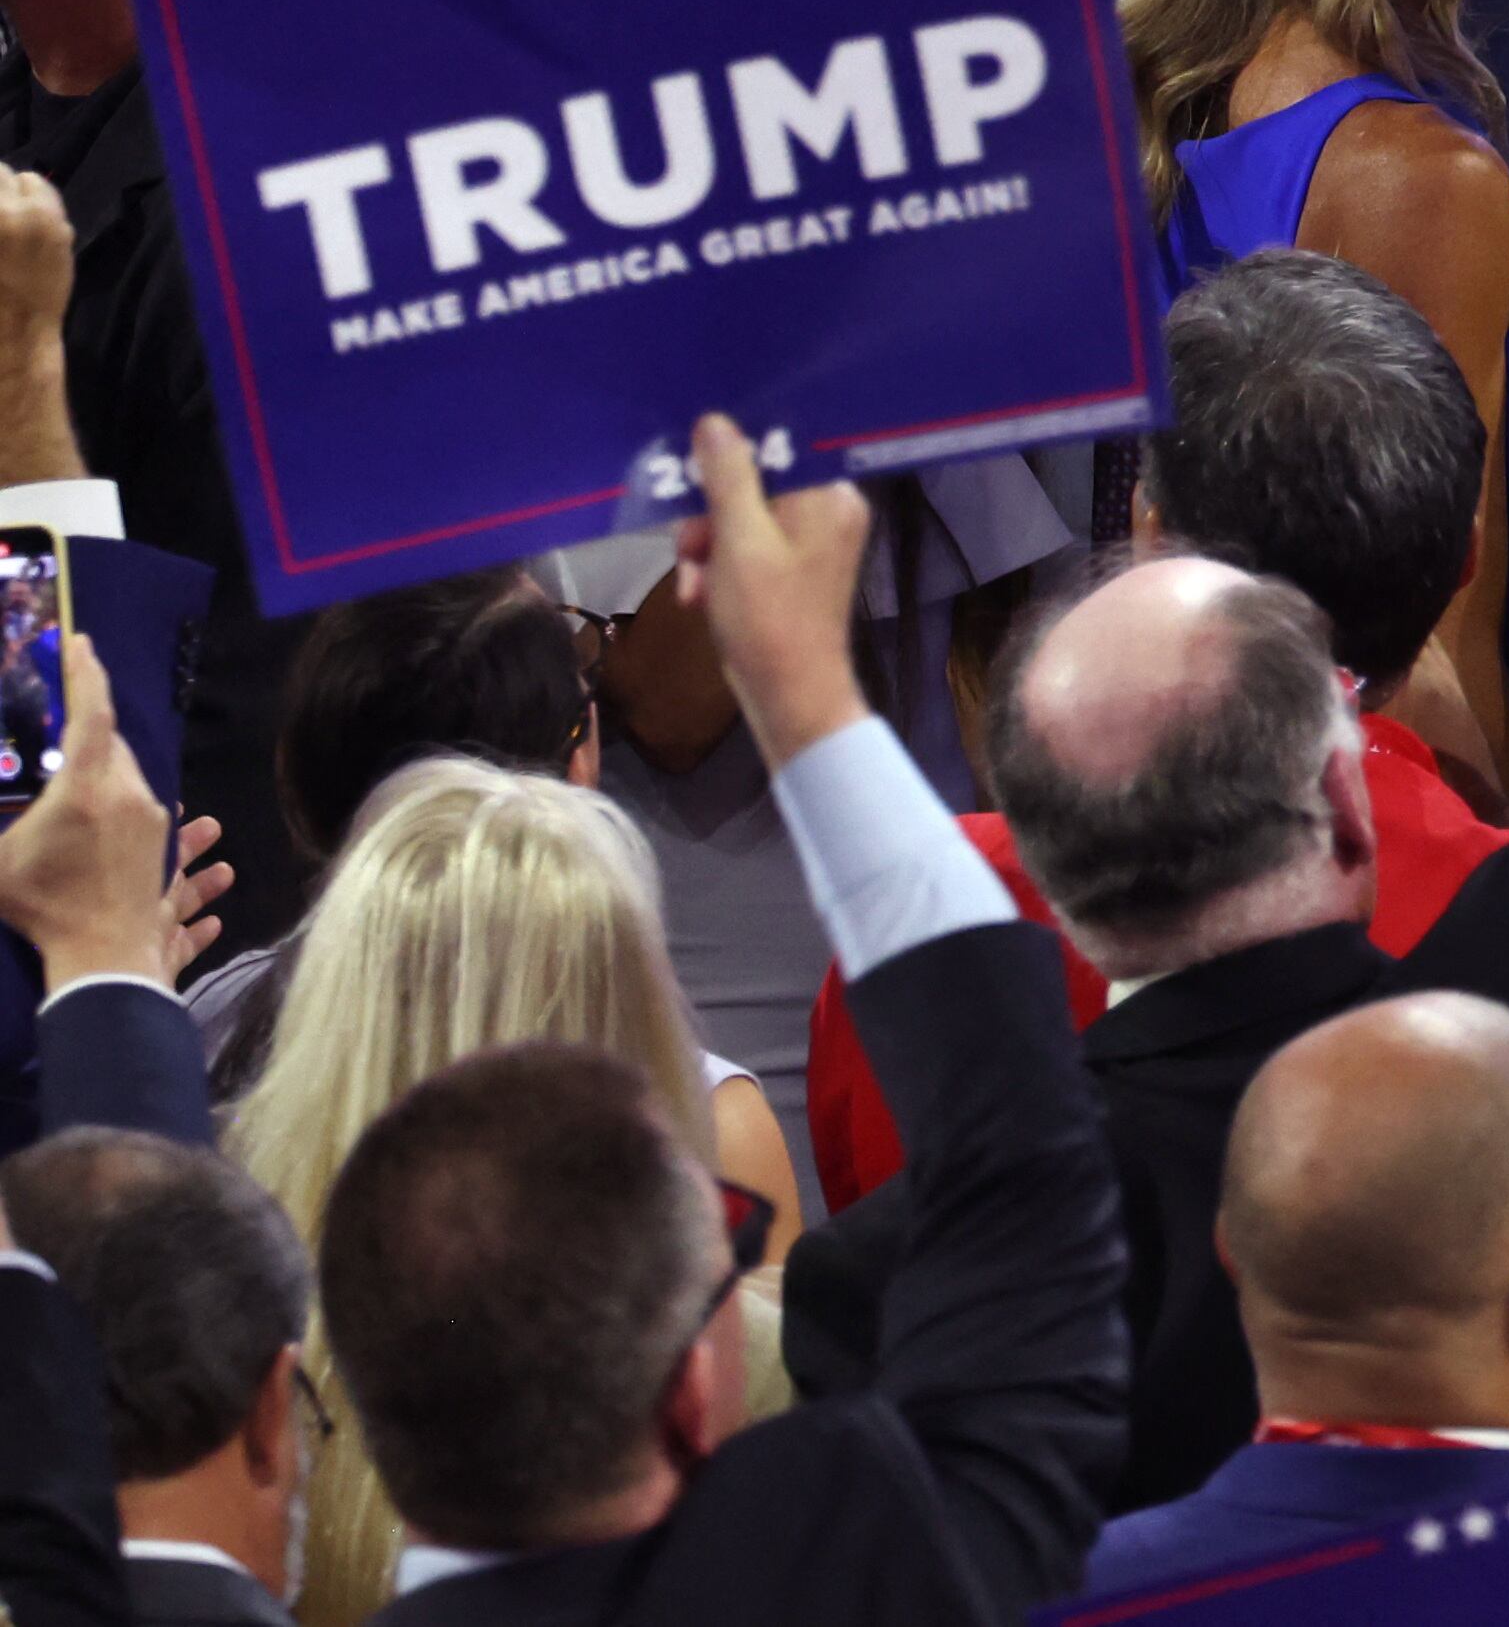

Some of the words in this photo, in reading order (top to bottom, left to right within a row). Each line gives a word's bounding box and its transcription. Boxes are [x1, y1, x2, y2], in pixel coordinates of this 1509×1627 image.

[257, 16, 1046, 298] TRUMP
[332, 293, 464, 351] MAKE
[479, 243, 687, 317] AMERICA
[701, 208, 852, 265] GREAT
[870, 178, 1030, 232] AGAIN!
[647, 426, 795, 499] 24
